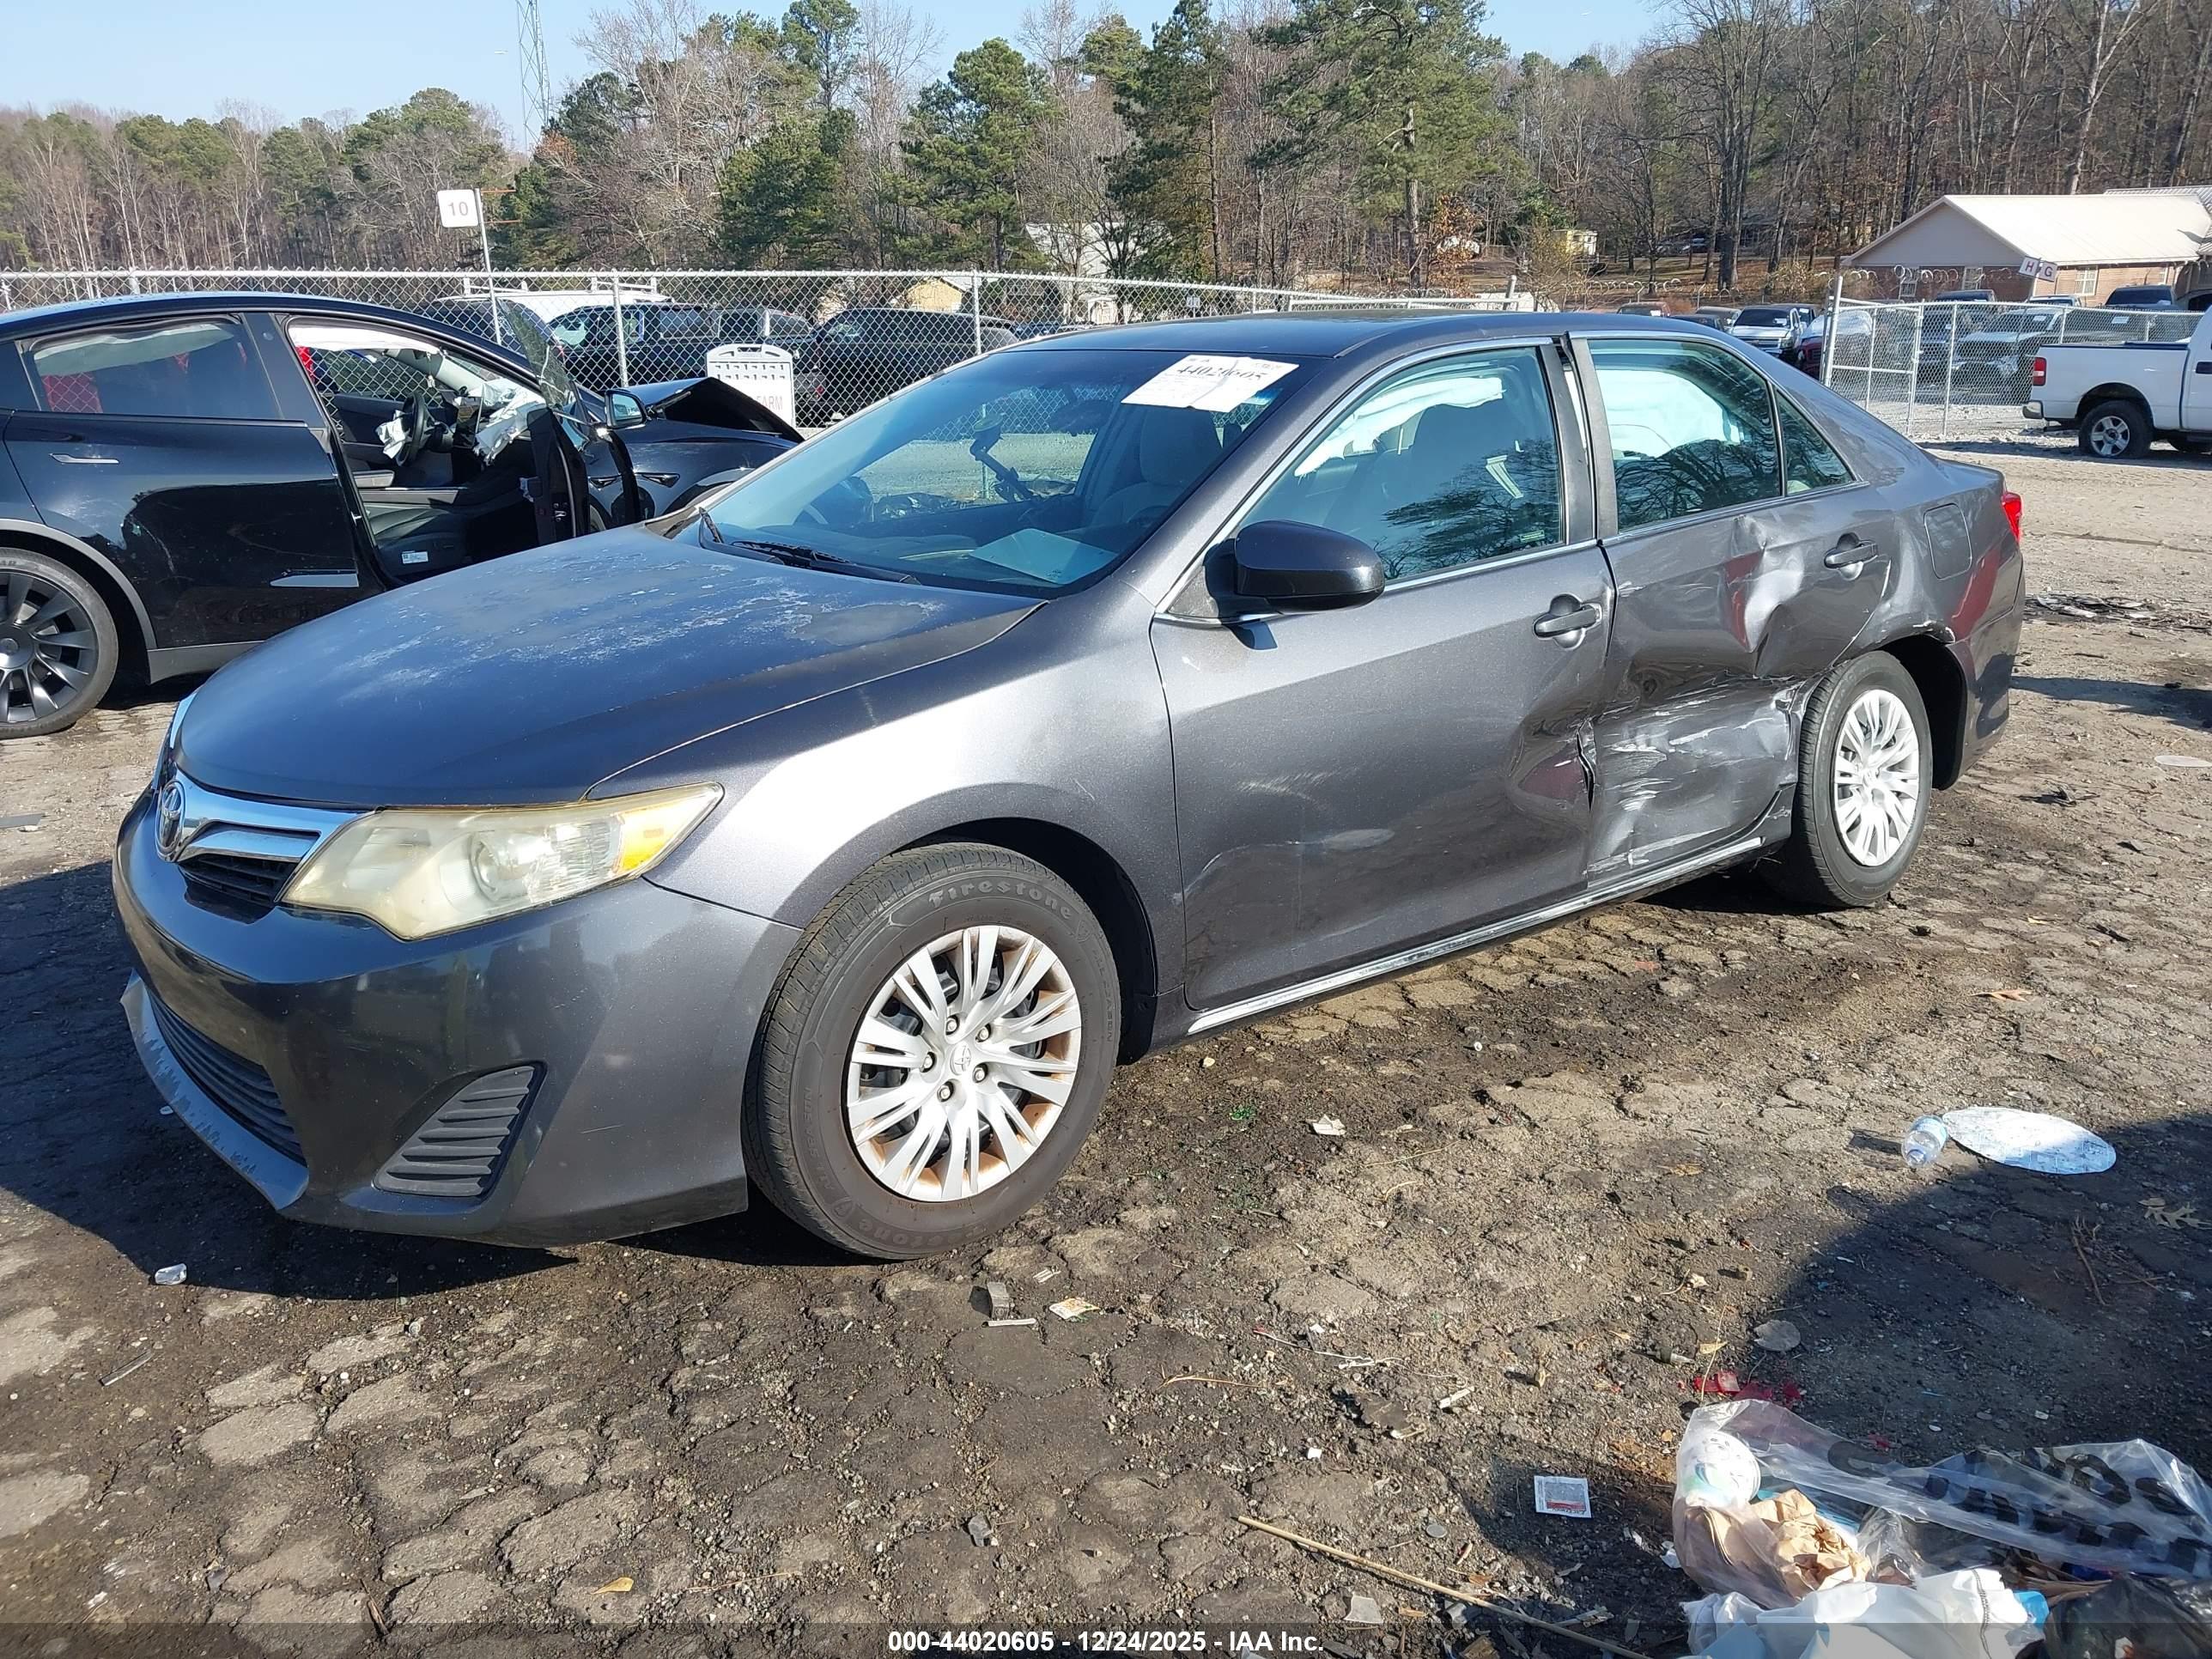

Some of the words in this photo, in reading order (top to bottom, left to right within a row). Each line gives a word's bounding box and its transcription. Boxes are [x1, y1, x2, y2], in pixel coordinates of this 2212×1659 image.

[447, 201, 469, 216] 10
[2025, 260, 2035, 272] H
[2044, 266, 2053, 277] G
[928, 880, 1072, 920] Firestone
